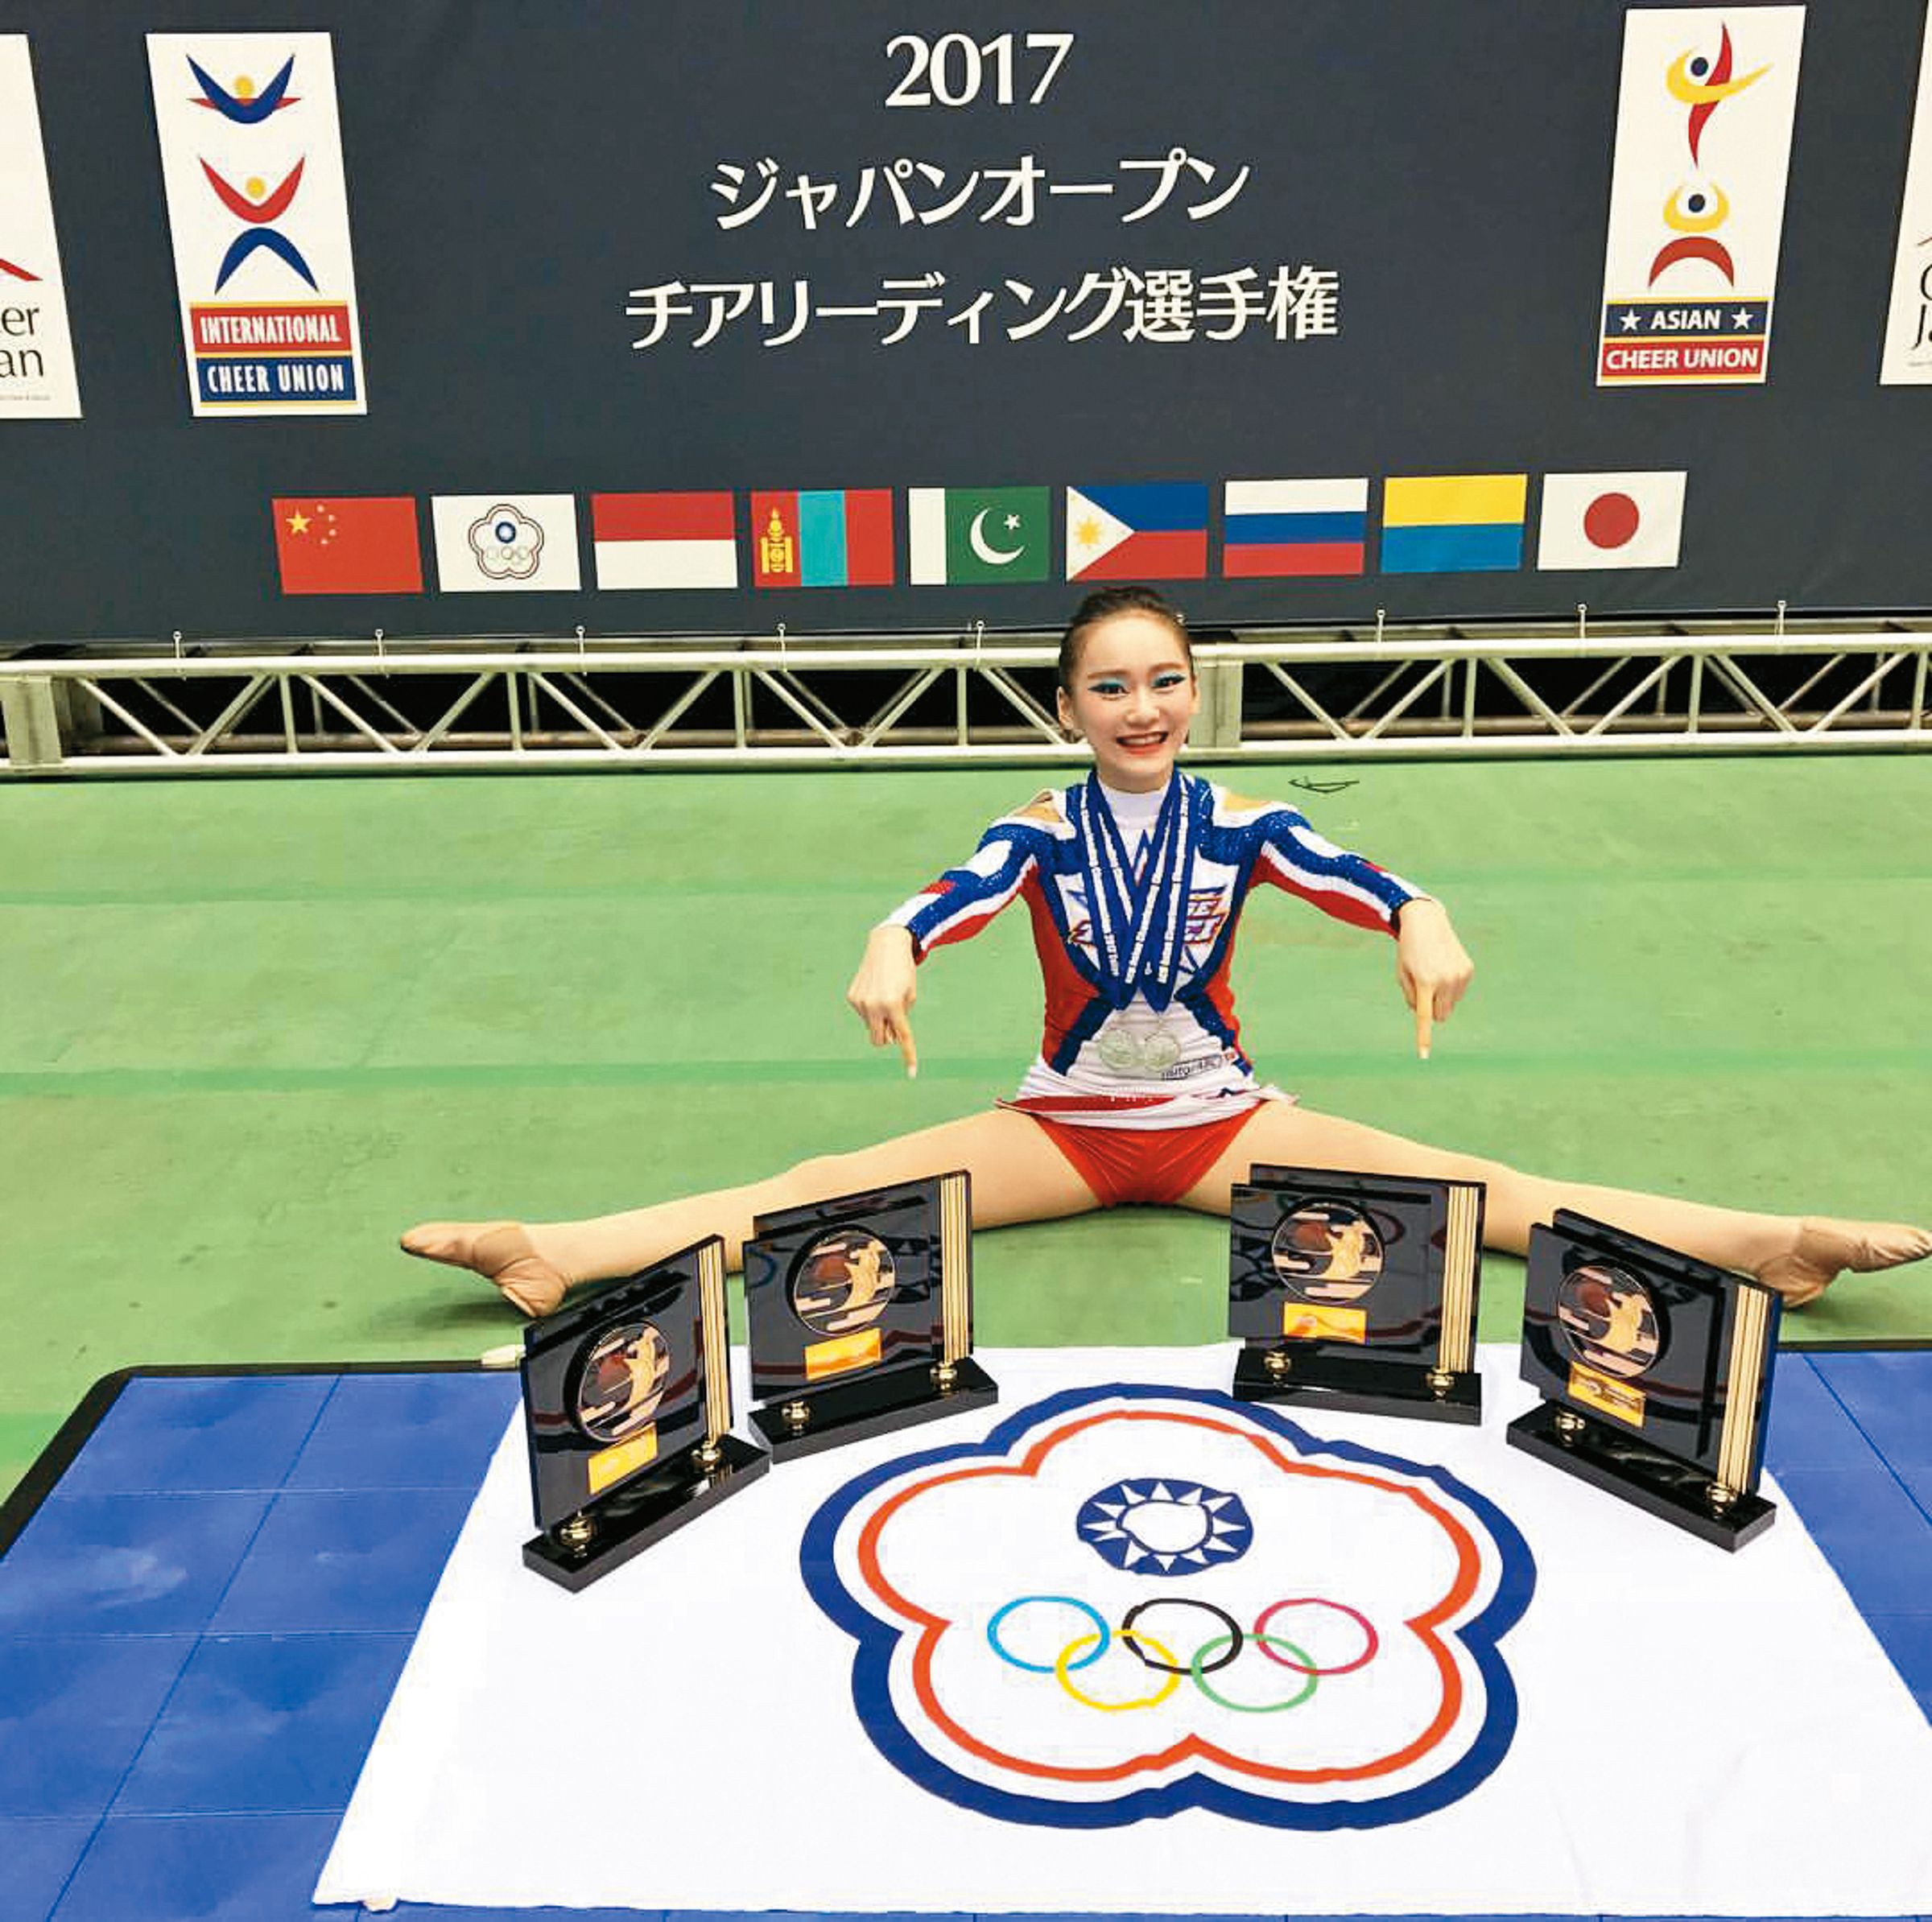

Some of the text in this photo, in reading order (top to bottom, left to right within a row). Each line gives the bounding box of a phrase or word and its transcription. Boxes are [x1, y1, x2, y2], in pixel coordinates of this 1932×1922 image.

[885, 33, 1074, 106] 2017
[710, 147, 1250, 230] ジャパンオープン
[625, 265, 1339, 349] チアリーディング選手権
[1651, 309, 1722, 330] ASIAN
[200, 315, 342, 344] INTERNATIONAL
[1606, 347, 1759, 369] CHEER UNION
[207, 364, 345, 393] CHEER UNION
